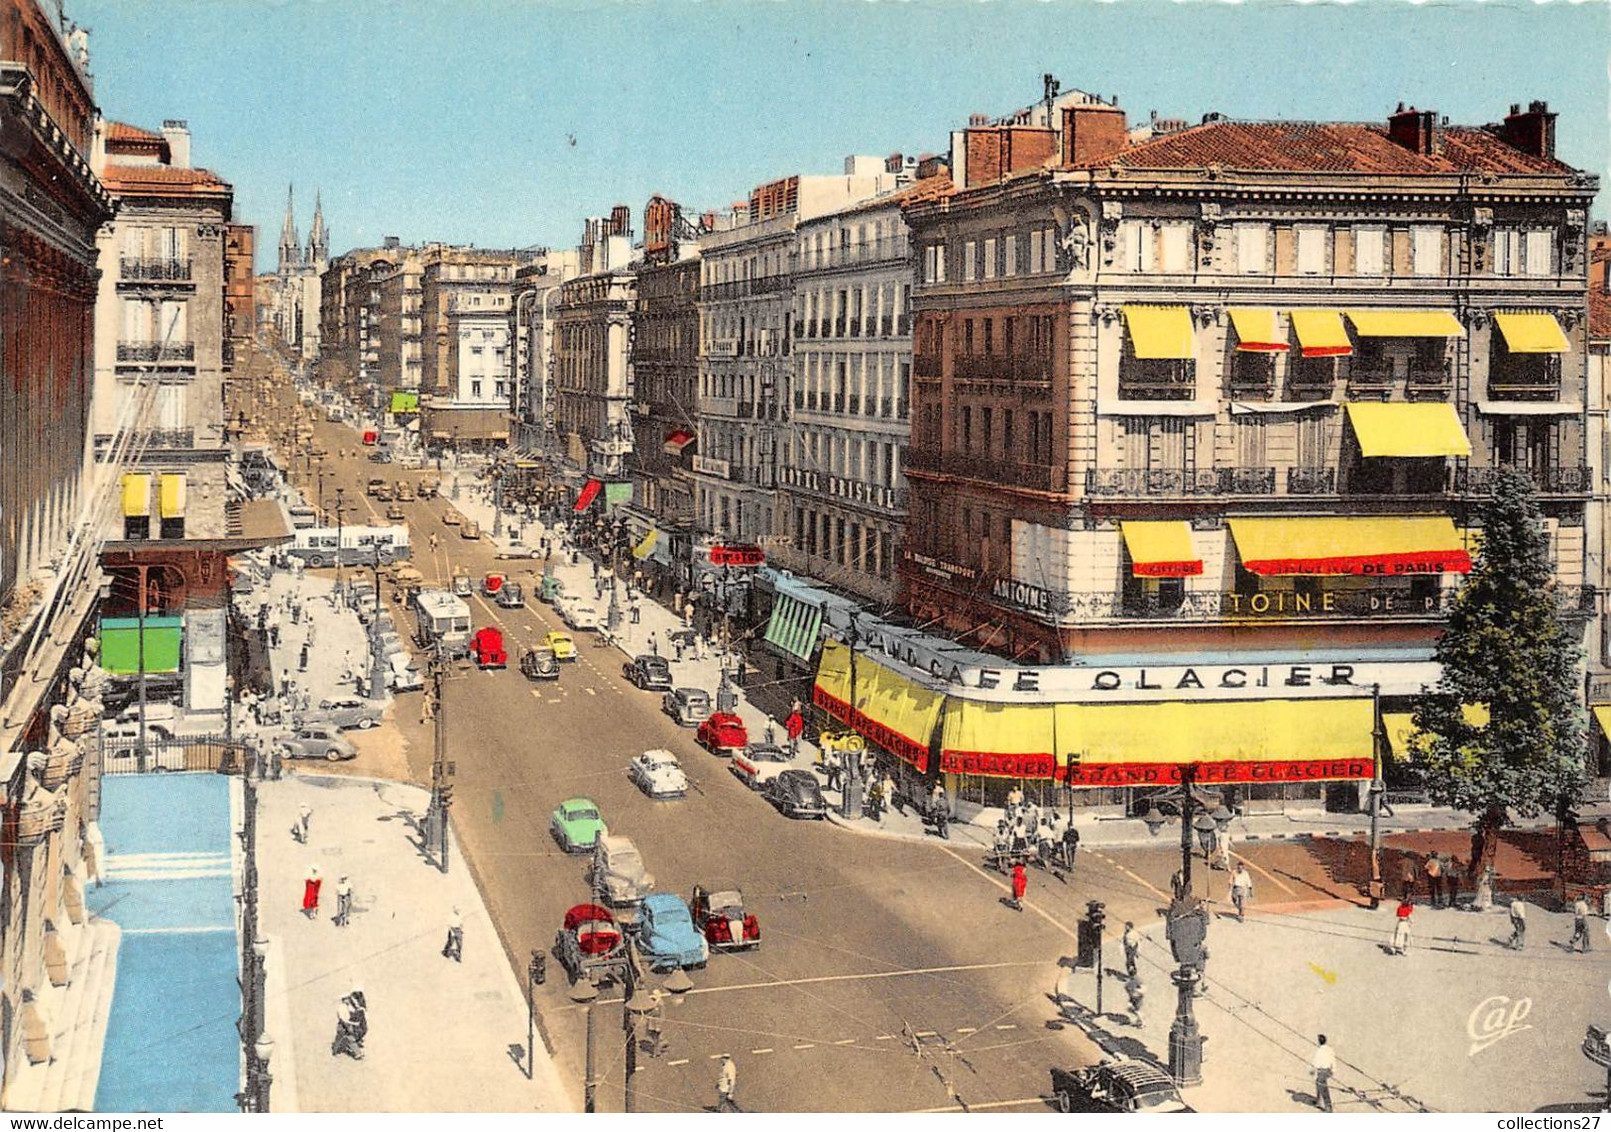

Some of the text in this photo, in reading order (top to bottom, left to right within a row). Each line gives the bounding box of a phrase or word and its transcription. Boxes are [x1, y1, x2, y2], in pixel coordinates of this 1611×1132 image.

[781, 467, 894, 509] HOTEL BRISTOL
[1363, 563, 1386, 574] DE
[1394, 562, 1444, 573] PARIS
[993, 579, 1048, 609] ANTOINE
[1177, 593, 1393, 617] ANTOINE DE
[1091, 665, 1354, 691] GLACIER
[963, 757, 1048, 775] GLACIER
[1252, 762, 1363, 779] GLACIER
